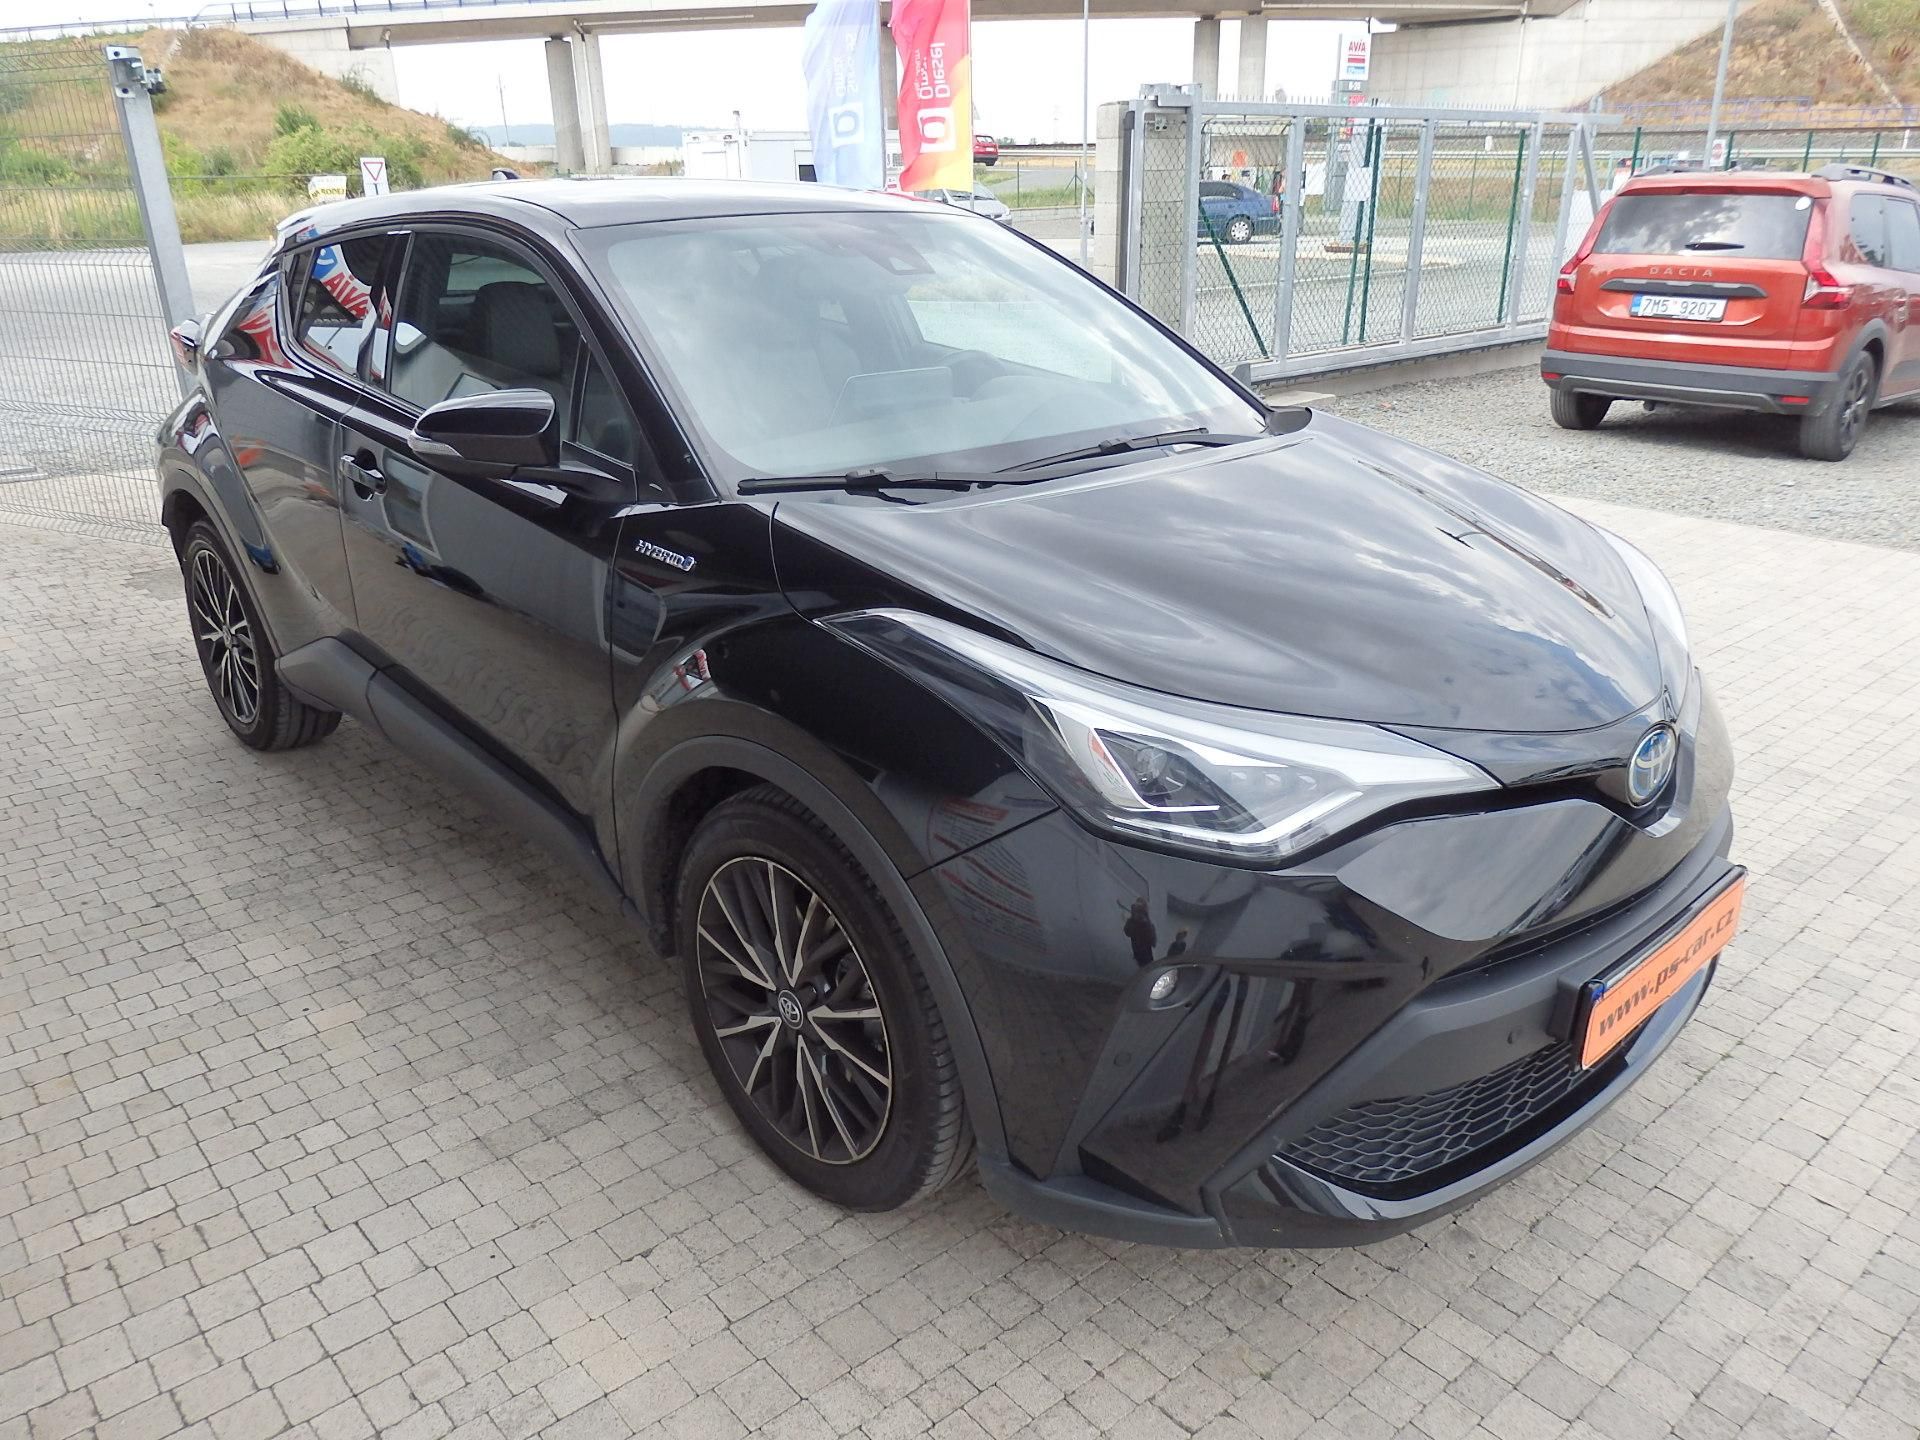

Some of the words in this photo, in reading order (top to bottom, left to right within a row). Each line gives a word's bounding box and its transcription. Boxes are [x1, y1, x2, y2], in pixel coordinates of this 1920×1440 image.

[1649, 267, 1713, 277] DACIA
[1642, 298, 1670, 313] 7M5
[1680, 301, 1717, 317] 9207
[635, 539, 691, 569] HYBRID
[1599, 907, 1735, 1037] www.ps-car.cz
